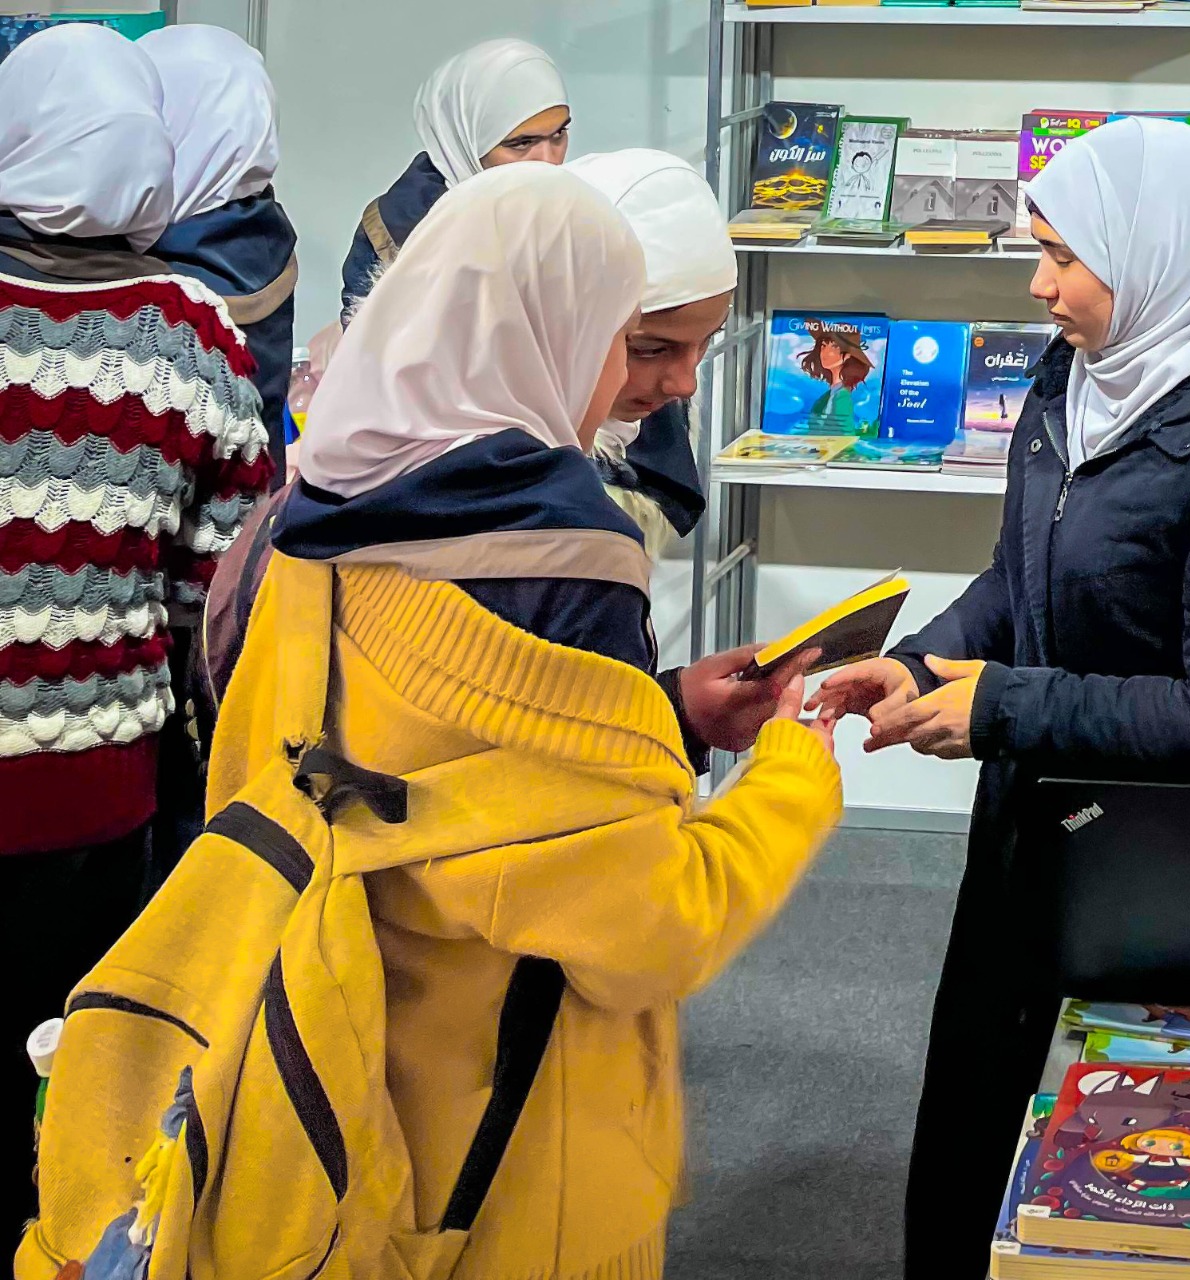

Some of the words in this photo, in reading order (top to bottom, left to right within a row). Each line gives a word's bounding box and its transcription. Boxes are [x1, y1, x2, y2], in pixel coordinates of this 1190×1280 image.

[1067, 118, 1081, 128] IQ
[788, 318, 820, 331] GIVING
[821, 320, 858, 334] WITHOUT
[860, 322, 881, 337] LIMITS
[897, 398, 928, 409] Soul
[1060, 801, 1104, 832] ThinkPad
[1148, 1202, 1175, 1212] ذات
